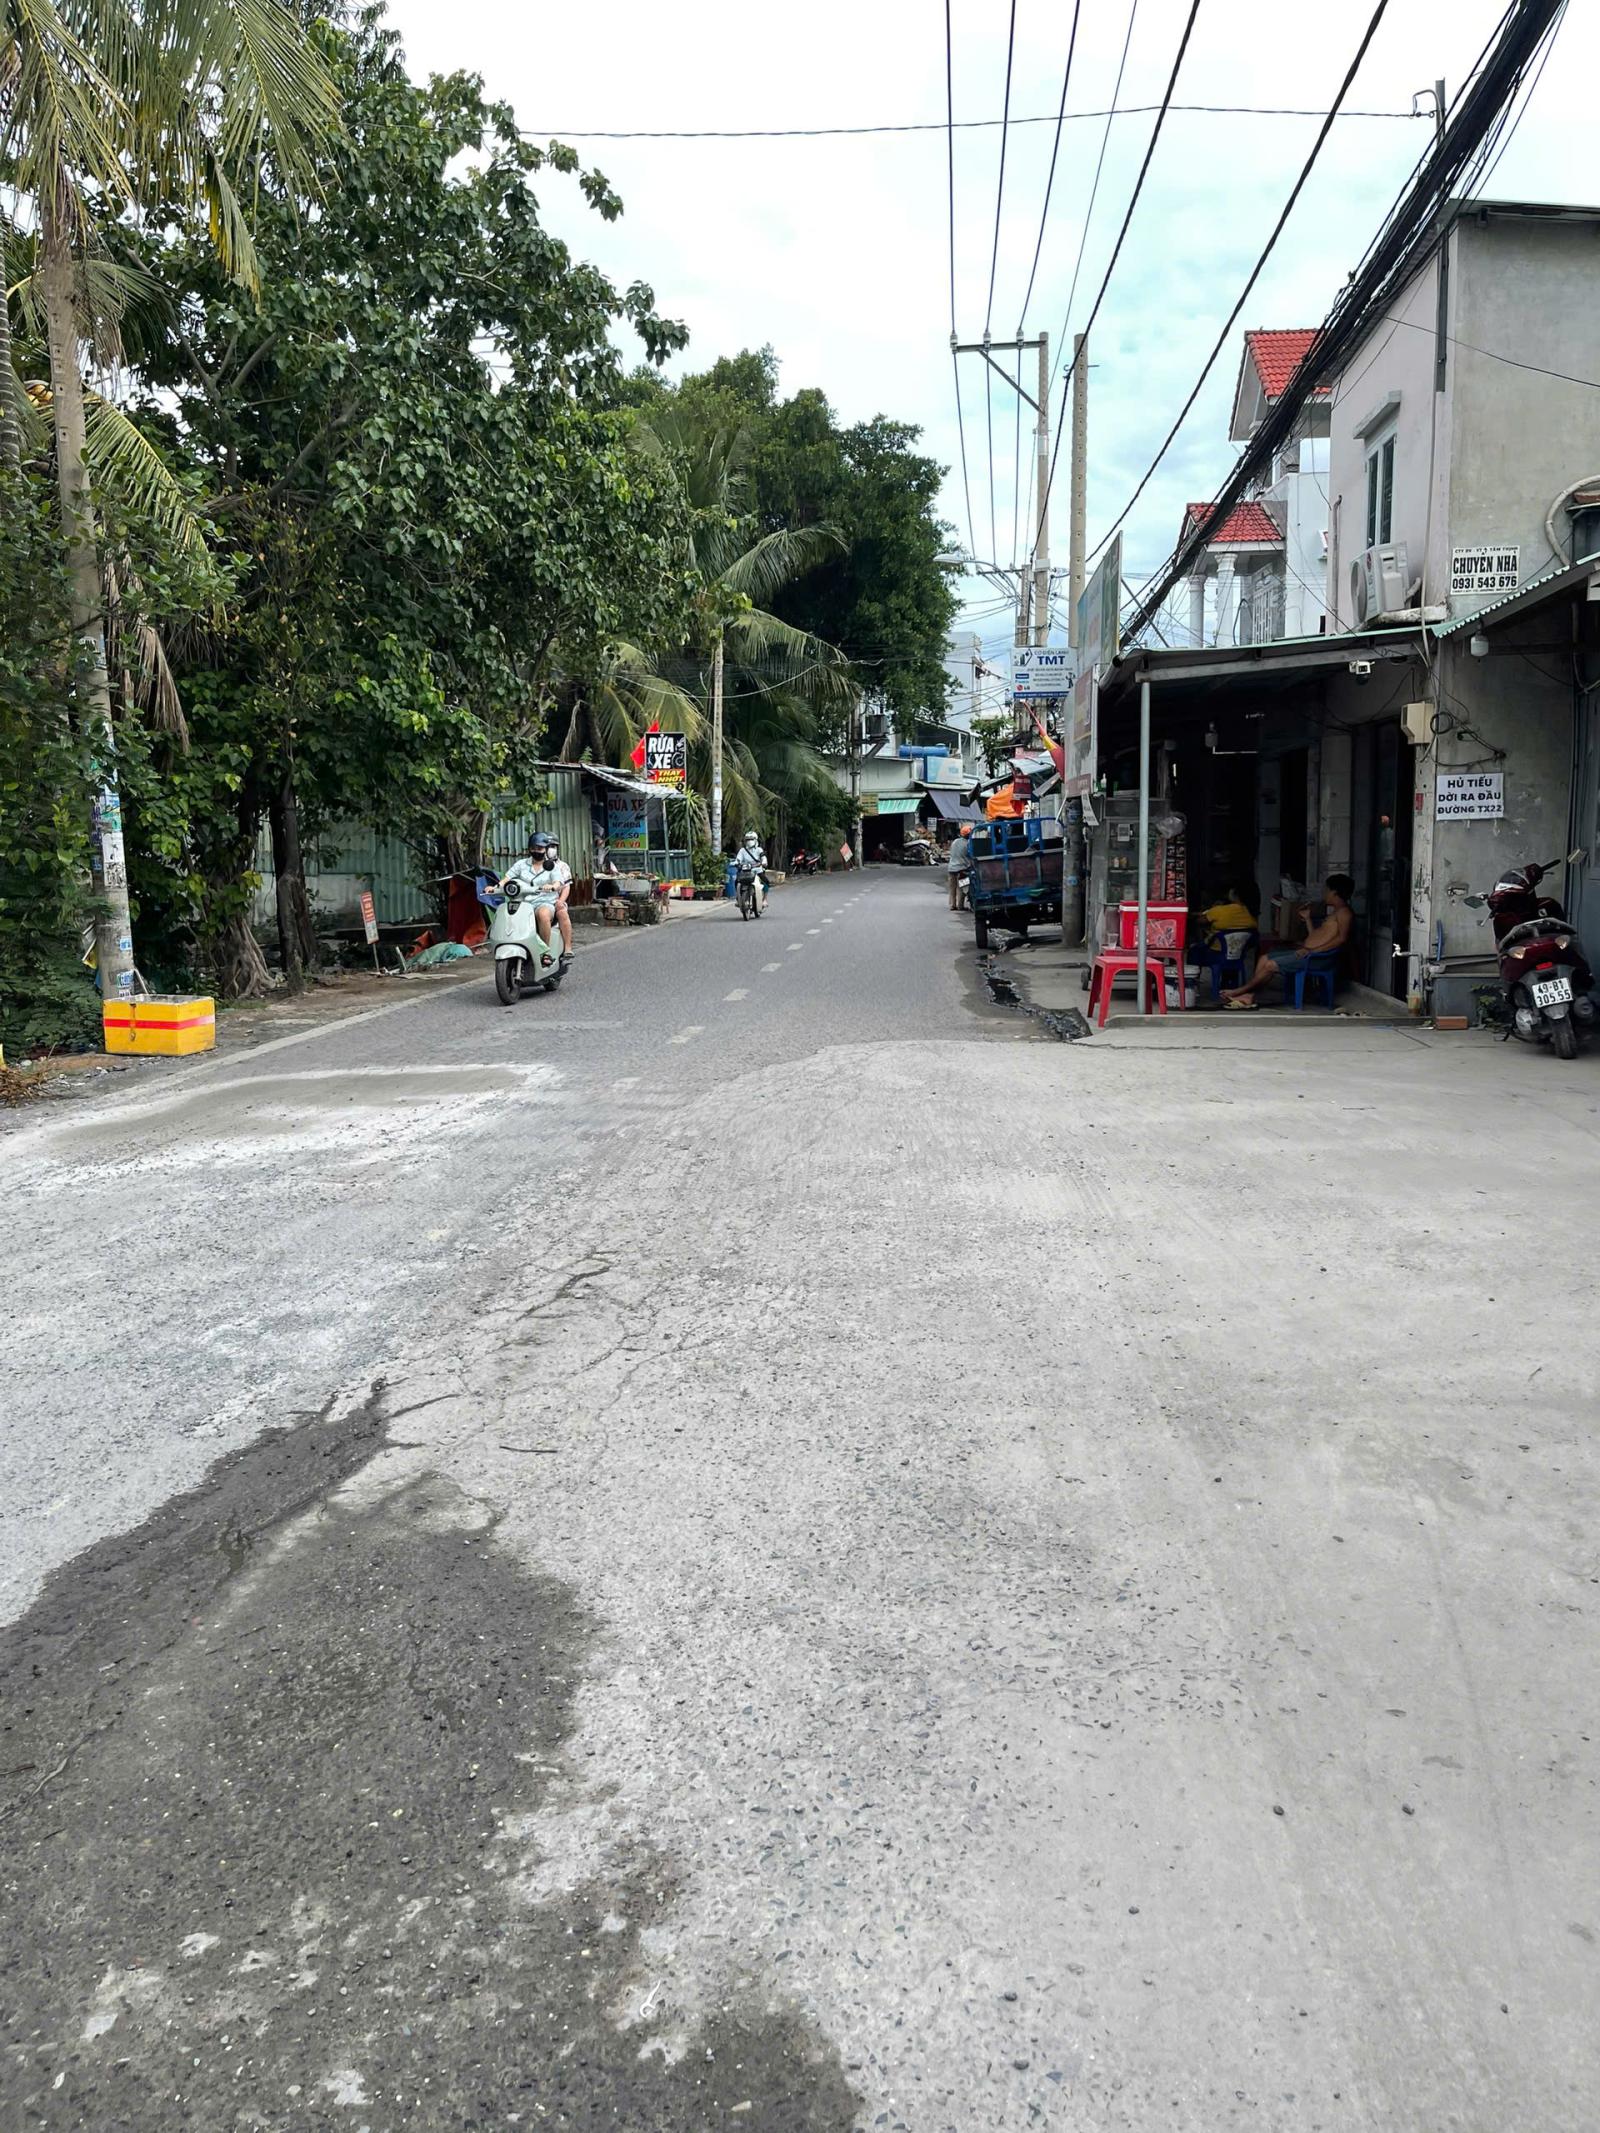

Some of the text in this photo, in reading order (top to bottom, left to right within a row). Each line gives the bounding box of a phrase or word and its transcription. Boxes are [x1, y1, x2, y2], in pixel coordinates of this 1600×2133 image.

[1452, 575, 1517, 589] 0931 543 676
[1037, 655, 1066, 665] TMT
[648, 733, 675, 753] RỬA
[652, 753, 672, 769] XE
[1447, 775, 1492, 788] HỦ TIẾU
[1438, 790, 1502, 802] DỜI RA ĐẦU
[1438, 804, 1502, 814] ĐƯỜNG TX22
[1537, 989, 1570, 1005] 305.55
